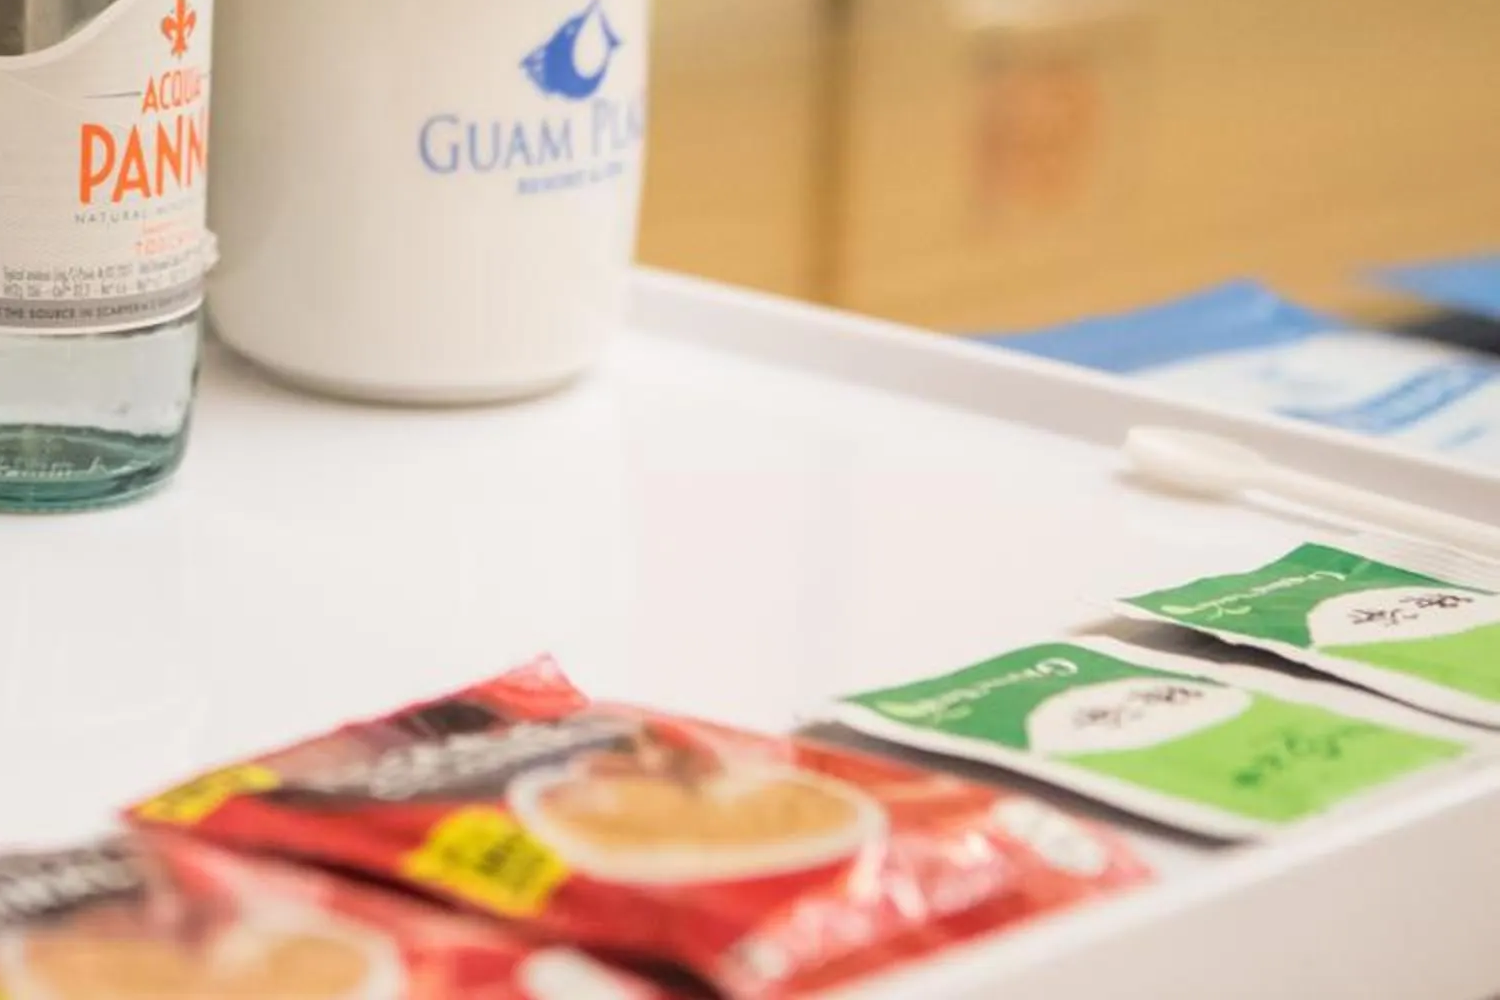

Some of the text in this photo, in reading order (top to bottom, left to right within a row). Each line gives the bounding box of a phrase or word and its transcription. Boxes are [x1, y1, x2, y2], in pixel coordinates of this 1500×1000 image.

[142, 67, 201, 115] ACQUA
[79, 112, 210, 206] PANN
[419, 113, 574, 175] GUAM
